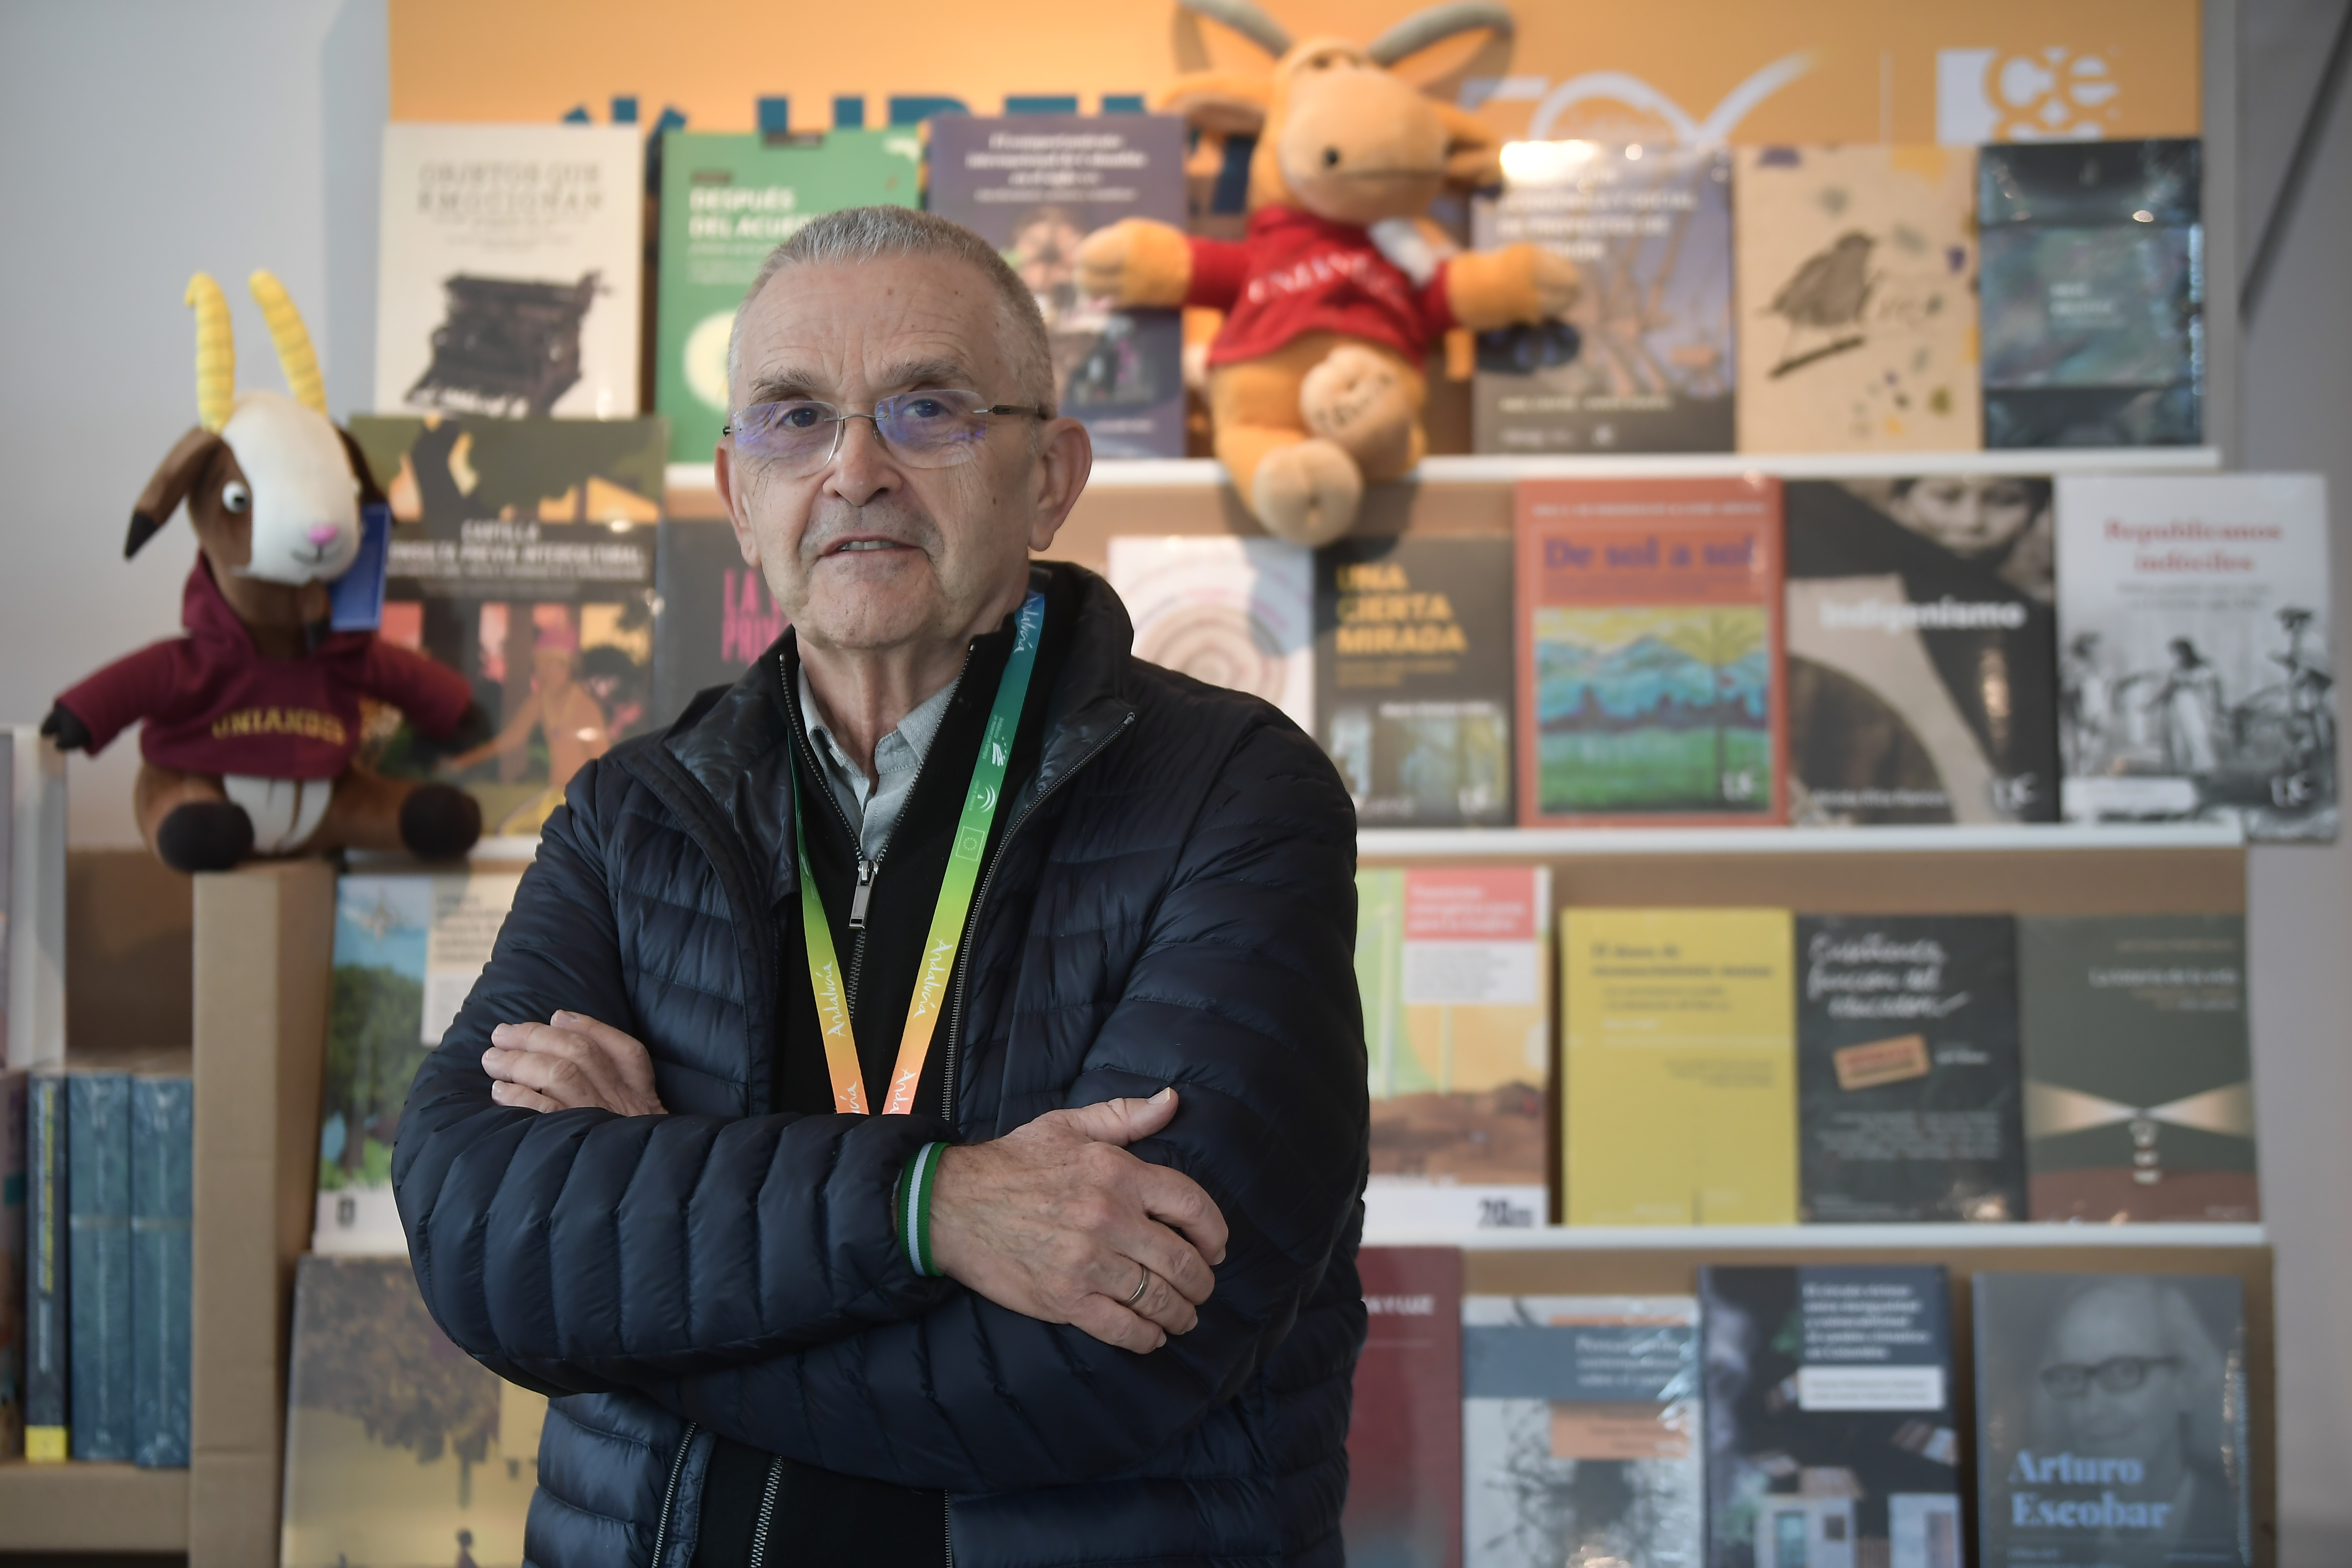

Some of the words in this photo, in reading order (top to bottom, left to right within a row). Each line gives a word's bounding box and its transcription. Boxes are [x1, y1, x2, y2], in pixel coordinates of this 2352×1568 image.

[2104, 518, 2283, 546] Republicanos
[1546, 536, 1595, 569] De
[1607, 535, 1659, 569] sol
[1671, 544, 1691, 569] a
[1820, 595, 2025, 634] Indigenismo
[1337, 626, 1467, 655] MIRADA
[913, 937, 953, 1019] Andalucía
[2006, 1450, 2145, 1485] Arturo
[2011, 1491, 2173, 1528] Escobar
